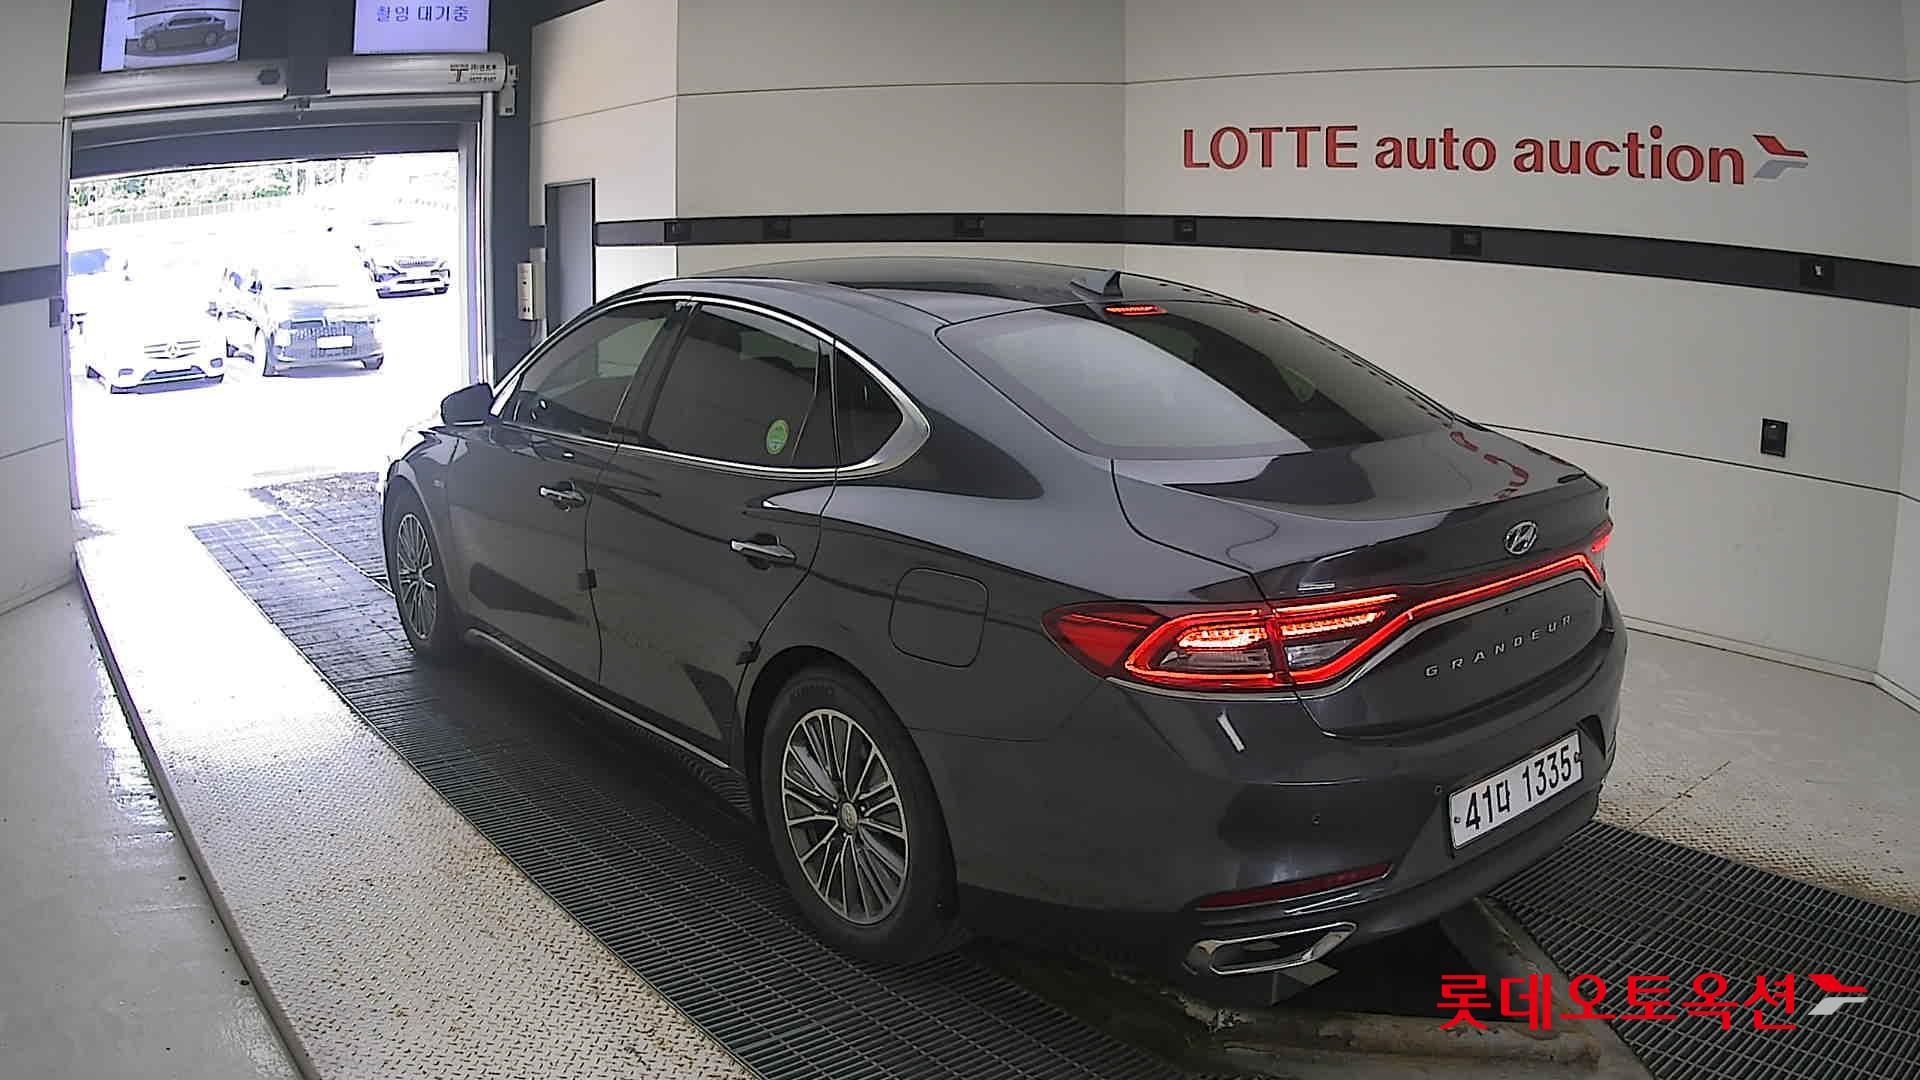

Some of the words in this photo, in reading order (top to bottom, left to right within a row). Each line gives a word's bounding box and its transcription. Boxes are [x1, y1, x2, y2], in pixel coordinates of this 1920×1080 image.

[417, 5, 469, 22] 대기중
[1182, 124, 1359, 170] LOTTE
[1374, 126, 1498, 172] auto
[1512, 124, 1745, 186] auction
[1425, 615, 1571, 677] GRANDEUR
[1521, 744, 1572, 802] 1335
